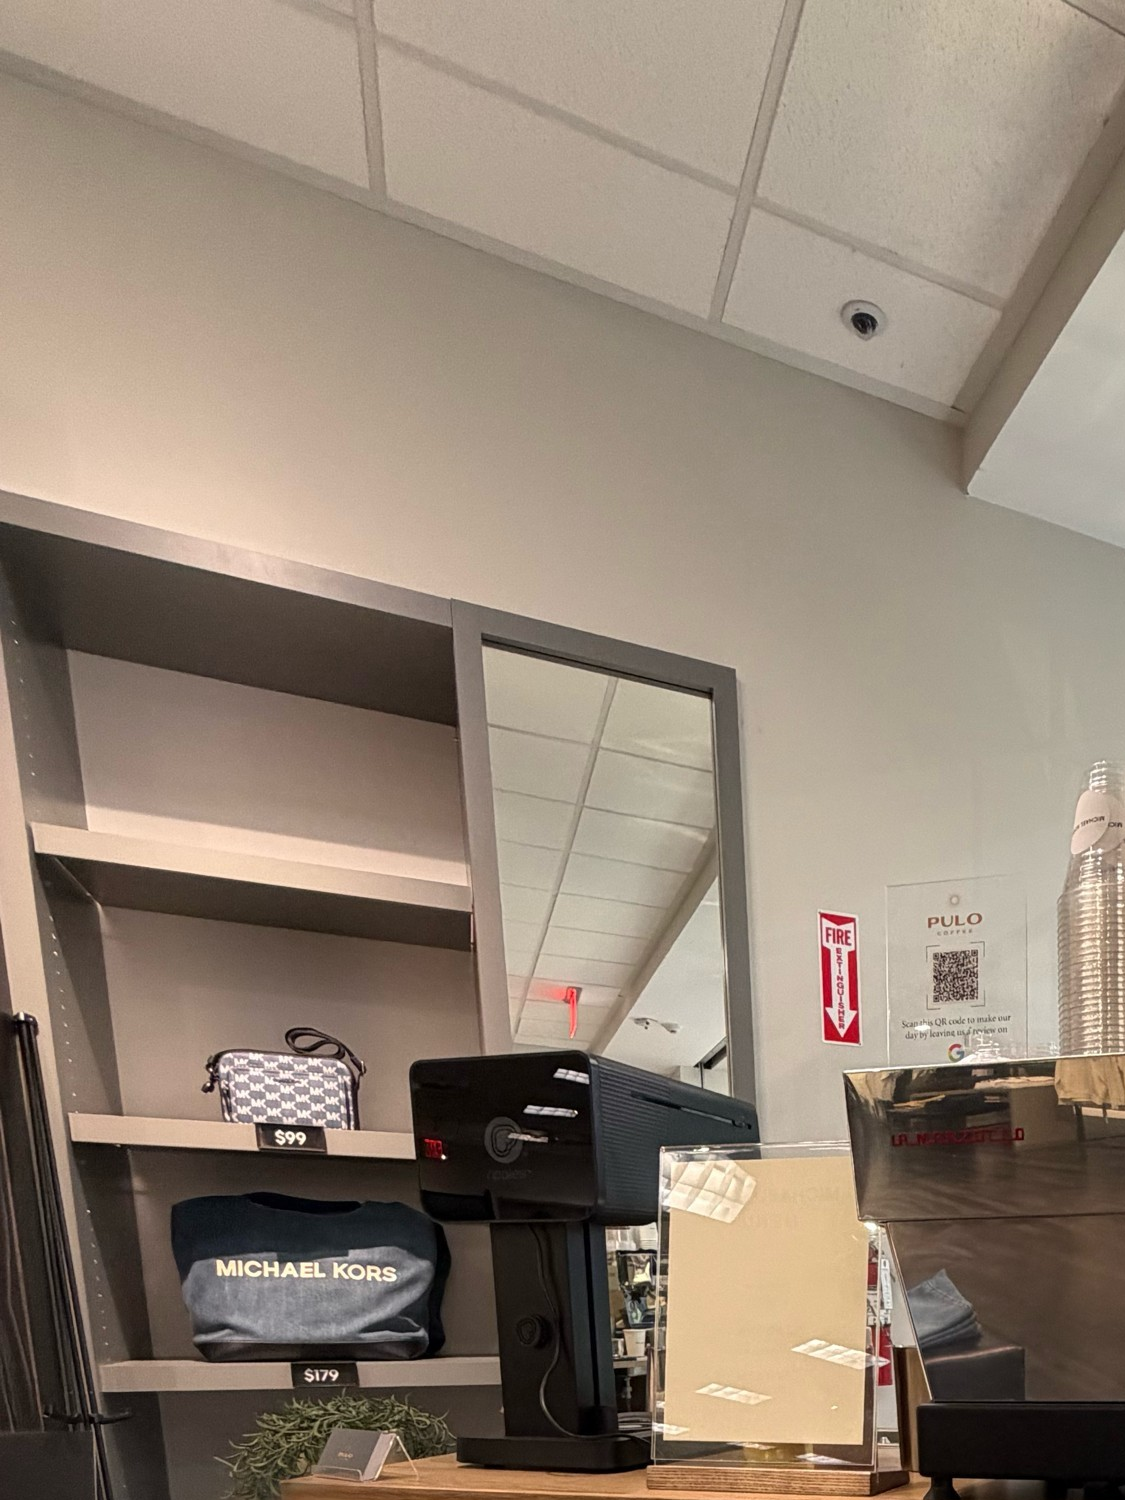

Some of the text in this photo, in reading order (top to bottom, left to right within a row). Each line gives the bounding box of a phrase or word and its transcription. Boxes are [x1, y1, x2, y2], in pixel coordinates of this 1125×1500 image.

[928, 913, 982, 928] PULO
[825, 927, 852, 946] FIRE
[836, 948, 845, 1029] EXTINGUISHER
[935, 1018, 947, 1026] QR
[949, 1017, 965, 1025] code
[977, 1015, 996, 1023] make
[905, 1031, 917, 1039] day
[920, 1030, 928, 1040] by
[930, 1029, 955, 1038] leaving
[973, 1027, 996, 1035] review
[279, 1056, 293, 1064] MK
[308, 1058, 322, 1066] MK
[279, 1071, 293, 1079] MK
[236, 1090, 250, 1098] MK
[251, 1099, 266, 1107] MK
[267, 1108, 282, 1116] MK
[297, 1110, 311, 1118] MK
[327, 1112, 340, 1120] MK
[275, 1130, 306, 1146] $99
[216, 1259, 397, 1282] MICHAEL KORS
[304, 1368, 339, 1382] $179
